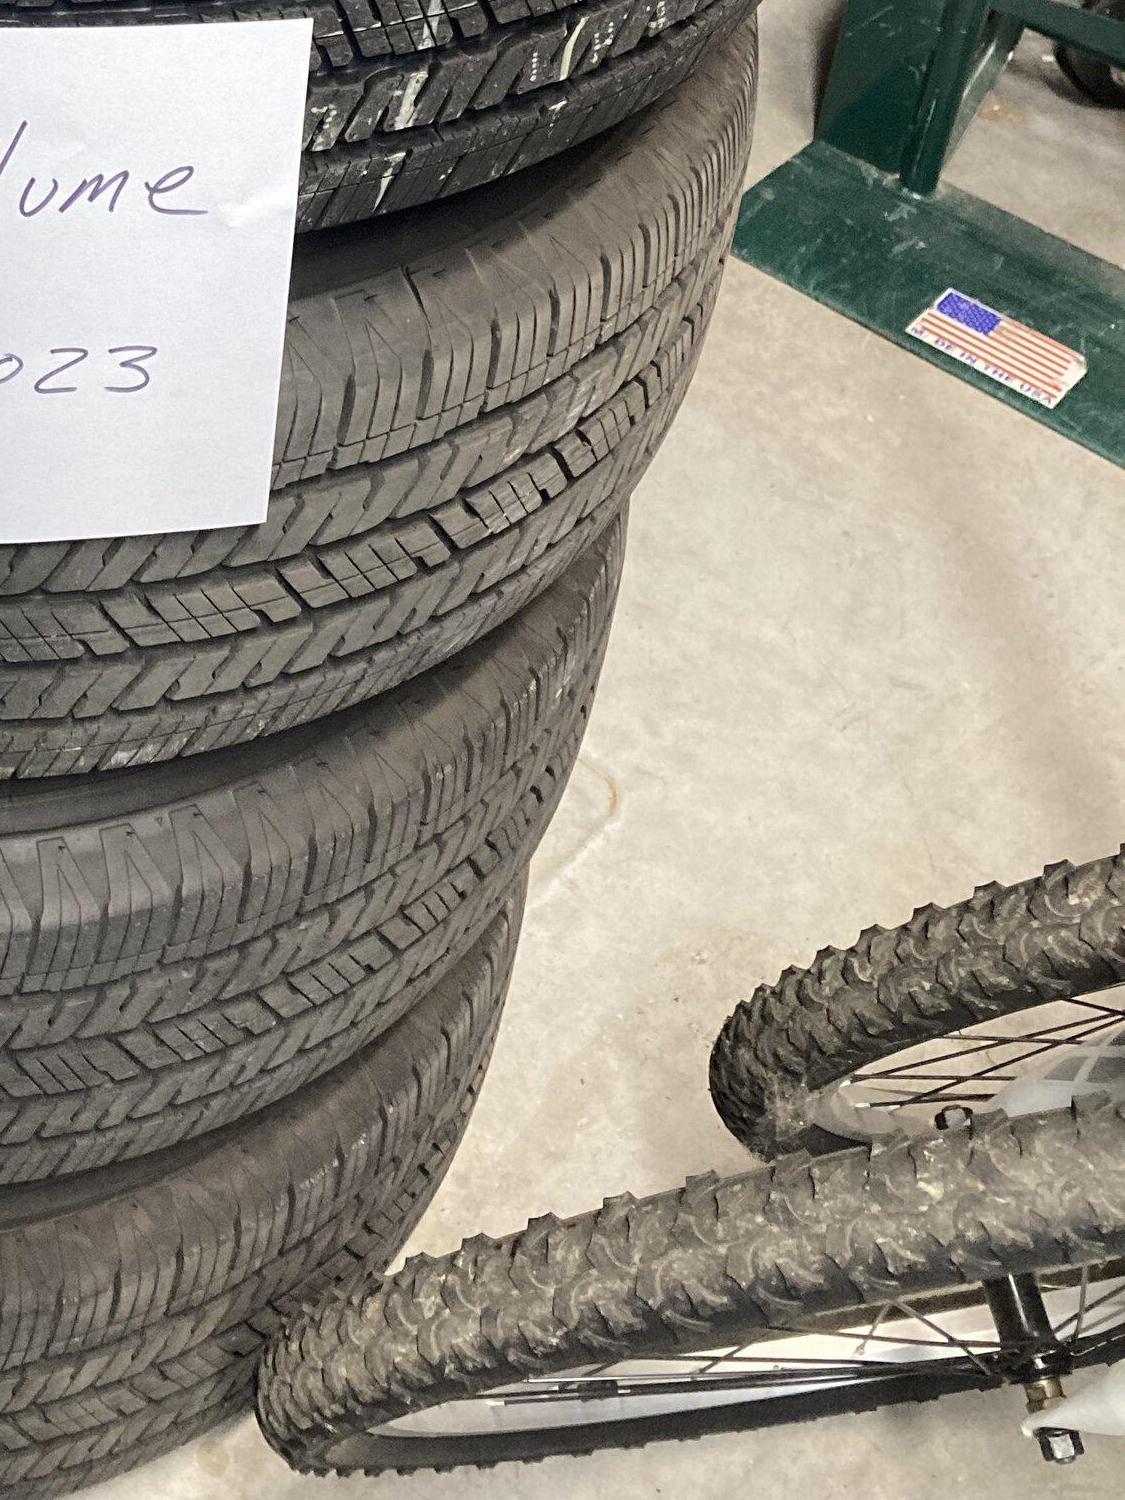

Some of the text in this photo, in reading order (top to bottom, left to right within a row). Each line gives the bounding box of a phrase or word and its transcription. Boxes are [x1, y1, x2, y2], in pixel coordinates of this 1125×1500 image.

[959, 350, 976, 365] IN
[983, 364, 1014, 385] THE
[1018, 382, 1052, 405] USA
